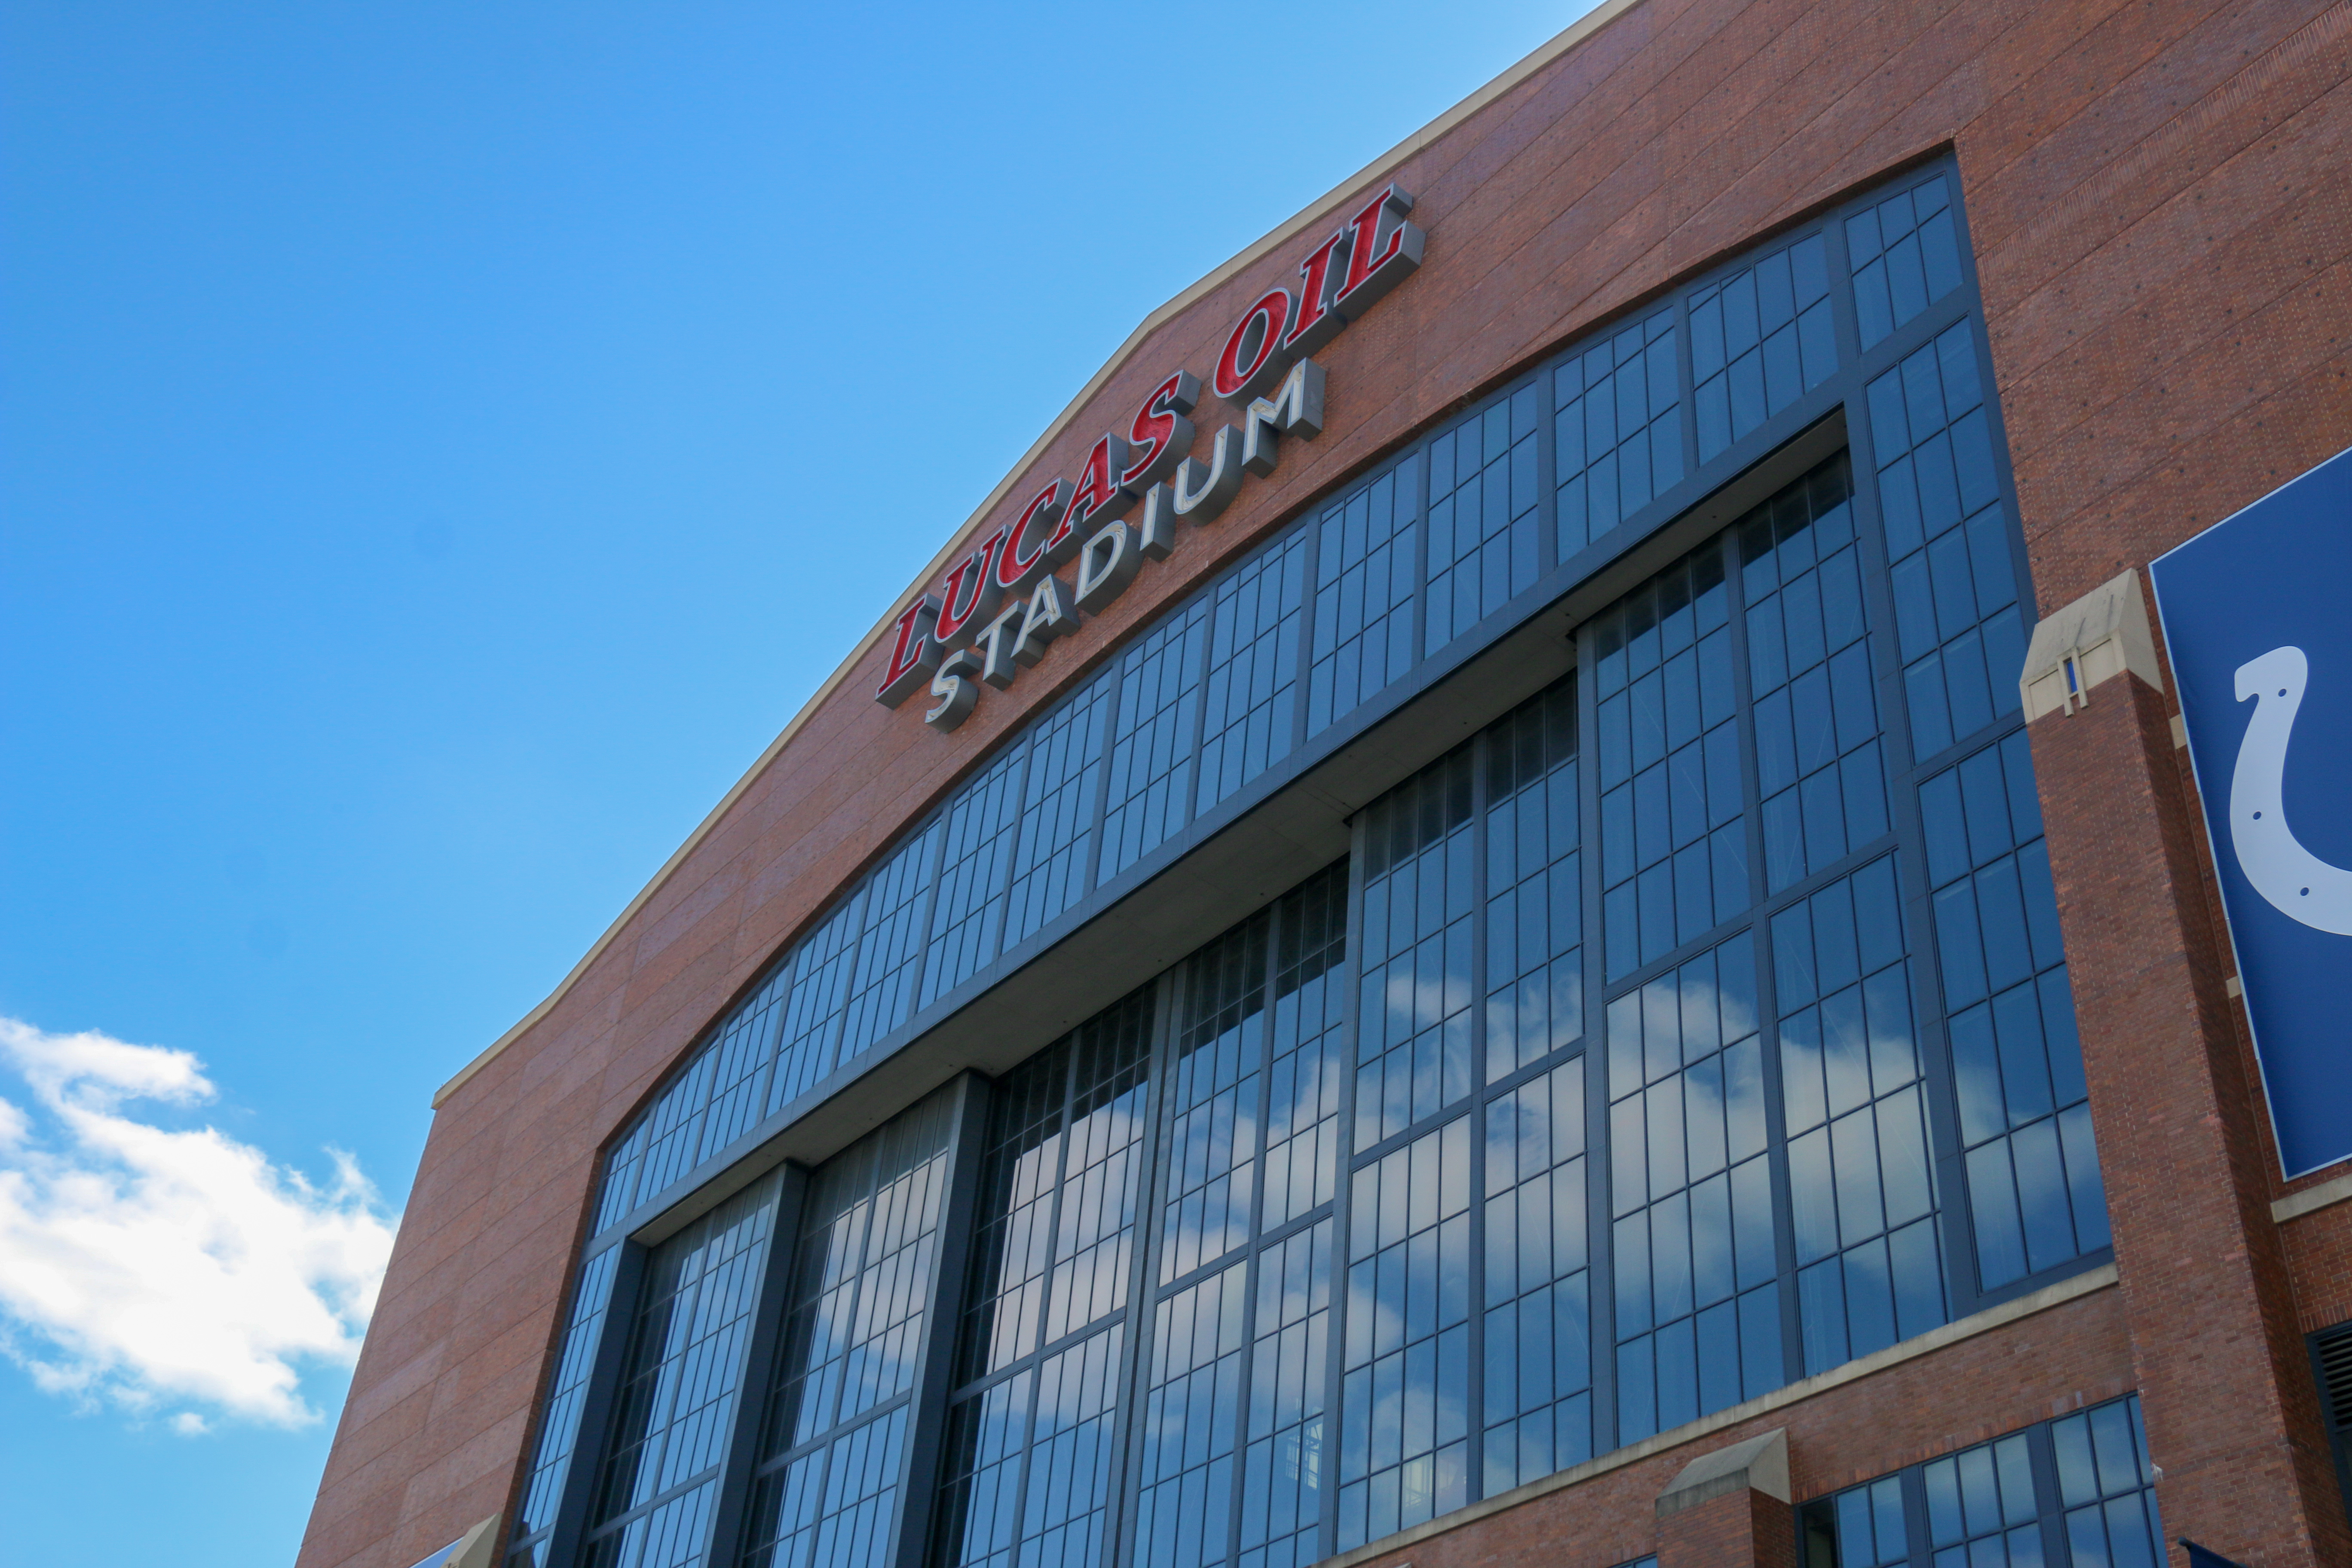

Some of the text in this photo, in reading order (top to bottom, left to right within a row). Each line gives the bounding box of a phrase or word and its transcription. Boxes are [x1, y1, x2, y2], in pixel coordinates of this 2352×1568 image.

[875, 182, 1412, 702] LUCAS OIL
[925, 356, 1316, 727] STADIUM
